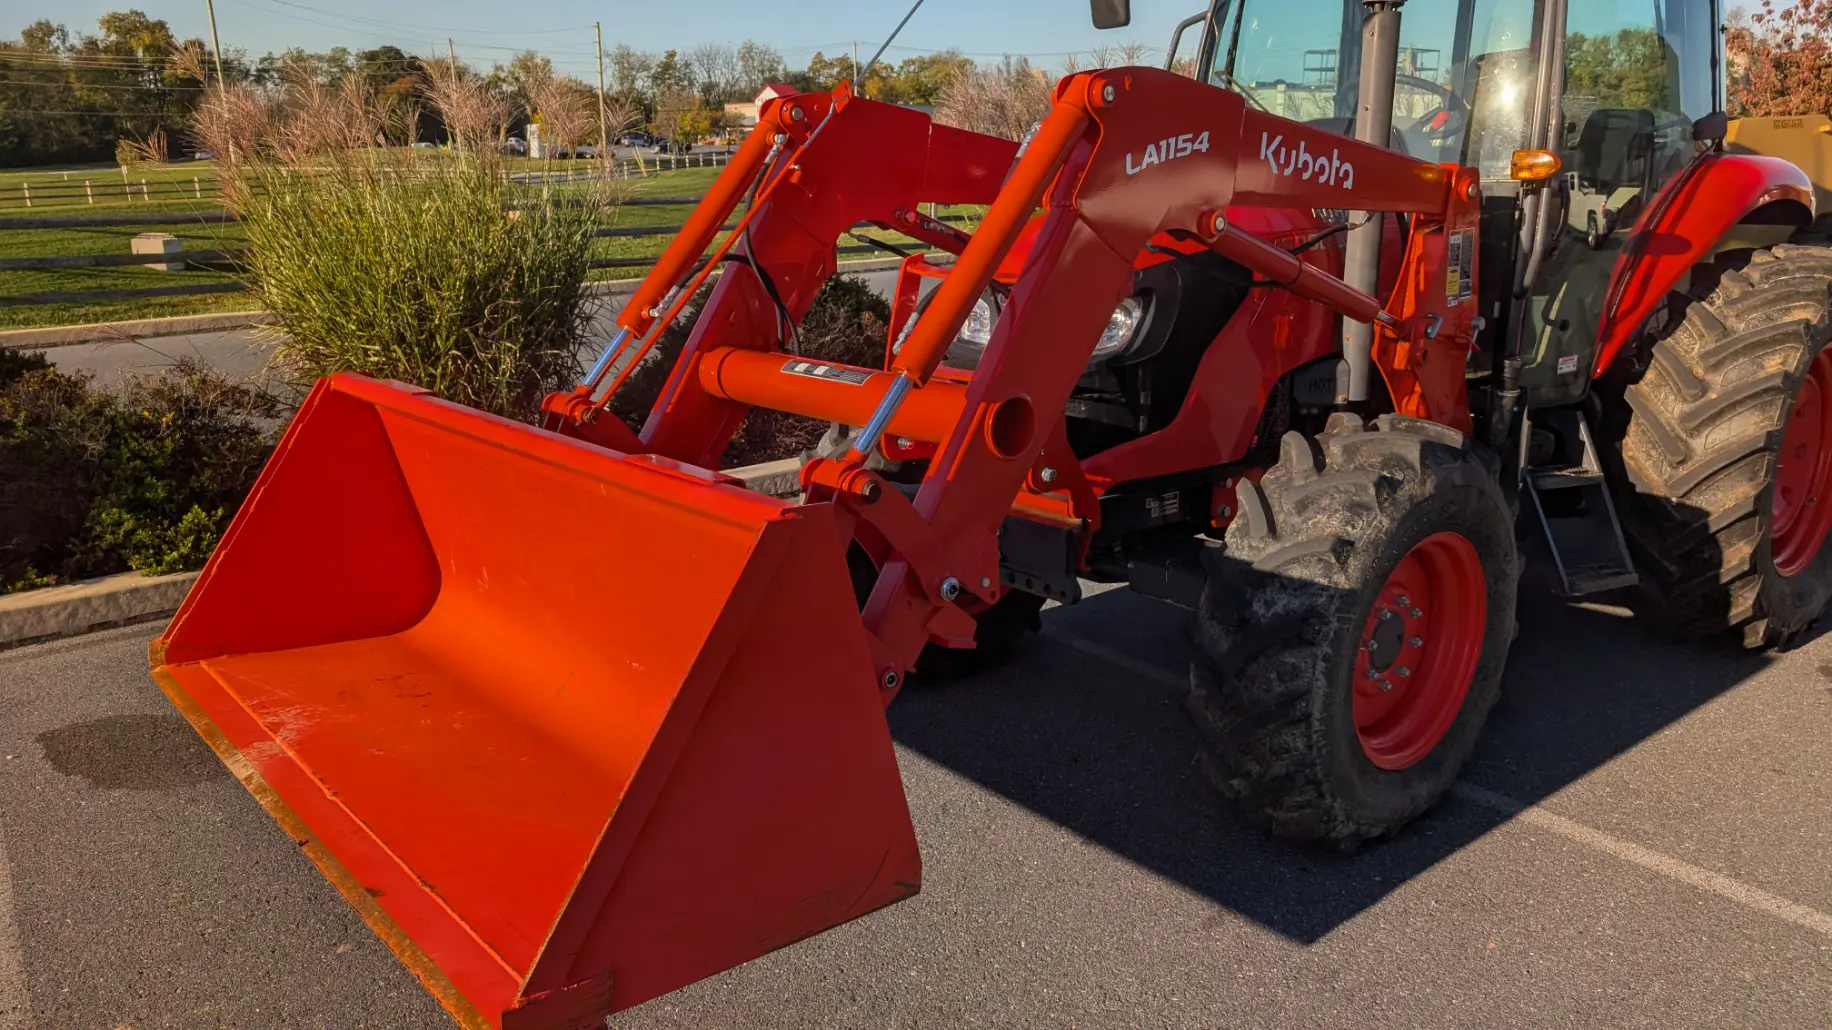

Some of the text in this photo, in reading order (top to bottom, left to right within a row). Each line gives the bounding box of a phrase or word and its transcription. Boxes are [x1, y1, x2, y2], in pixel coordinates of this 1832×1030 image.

[1126, 131, 1210, 175] LA1154
[1260, 131, 1354, 189] Kubota
[1308, 378, 1333, 393] HOT
